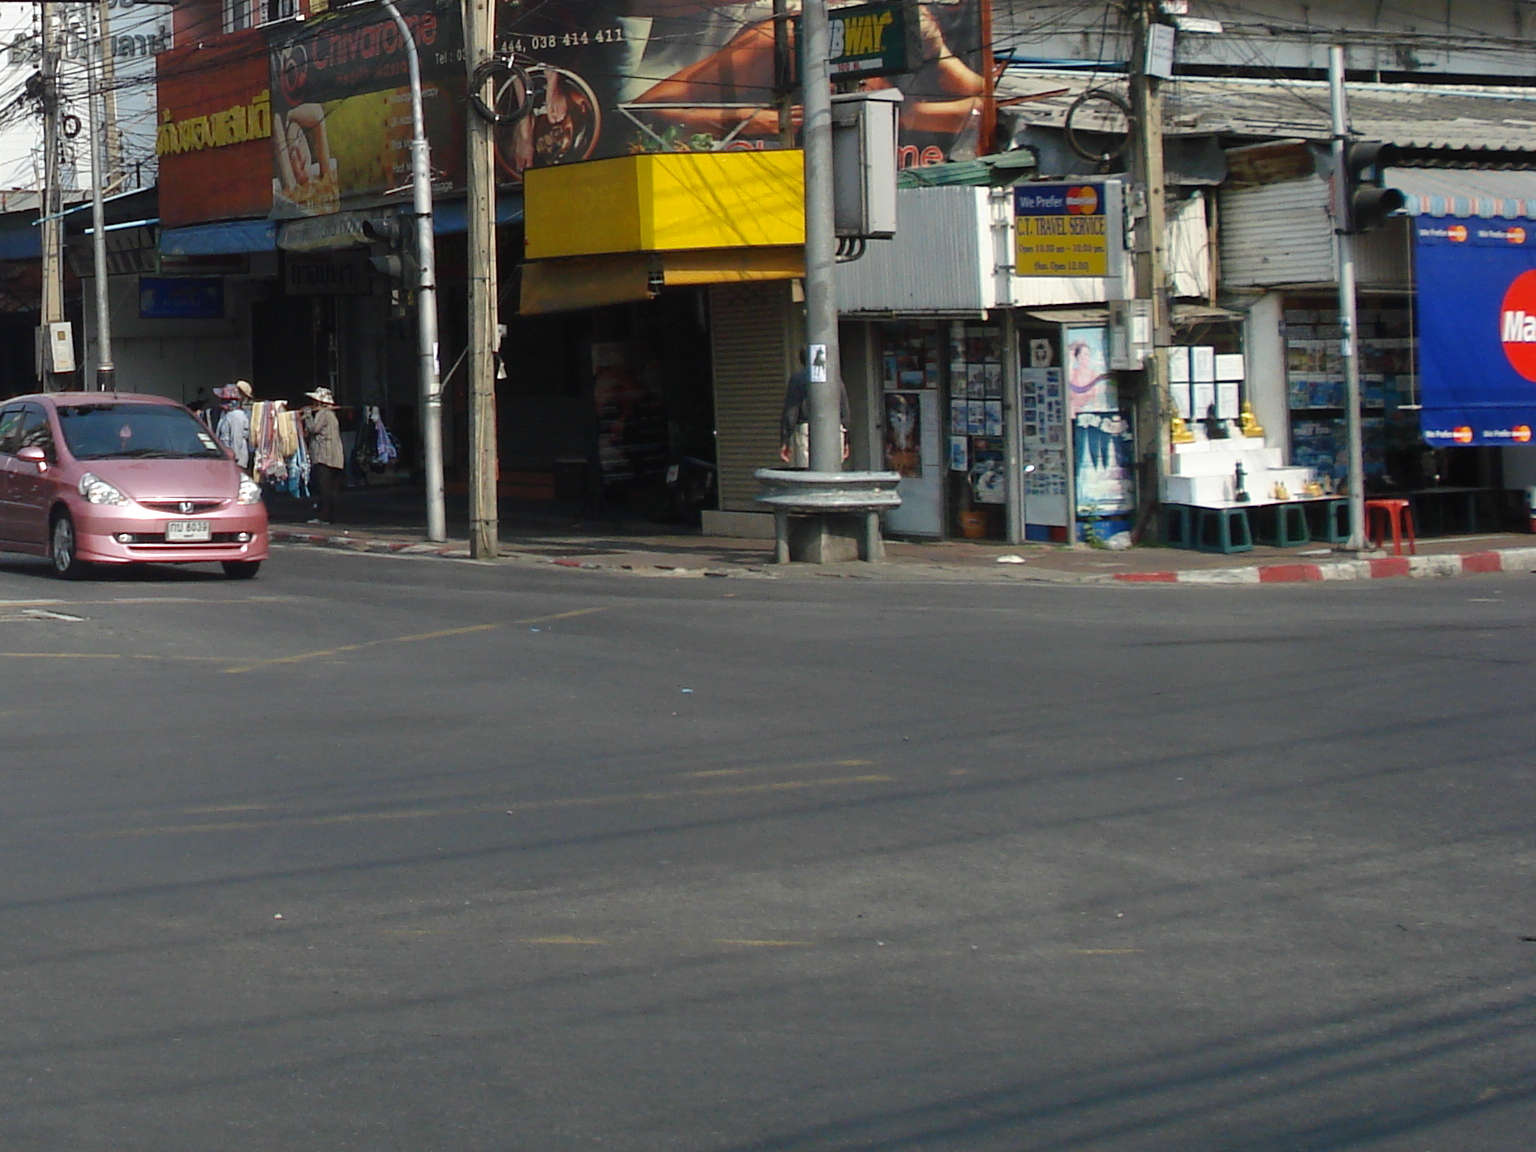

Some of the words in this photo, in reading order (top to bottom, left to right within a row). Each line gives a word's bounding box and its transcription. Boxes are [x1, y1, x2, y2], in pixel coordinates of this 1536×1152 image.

[531, 34, 557, 50] 038
[562, 31, 590, 47] 414
[595, 28, 624, 44] 411
[828, 11, 894, 60] BWAY
[1019, 196, 1035, 208] We
[1036, 195, 1064, 208] Prefer
[1035, 217, 1067, 236] TRAVEL
[1069, 217, 1106, 236] SERVICE
